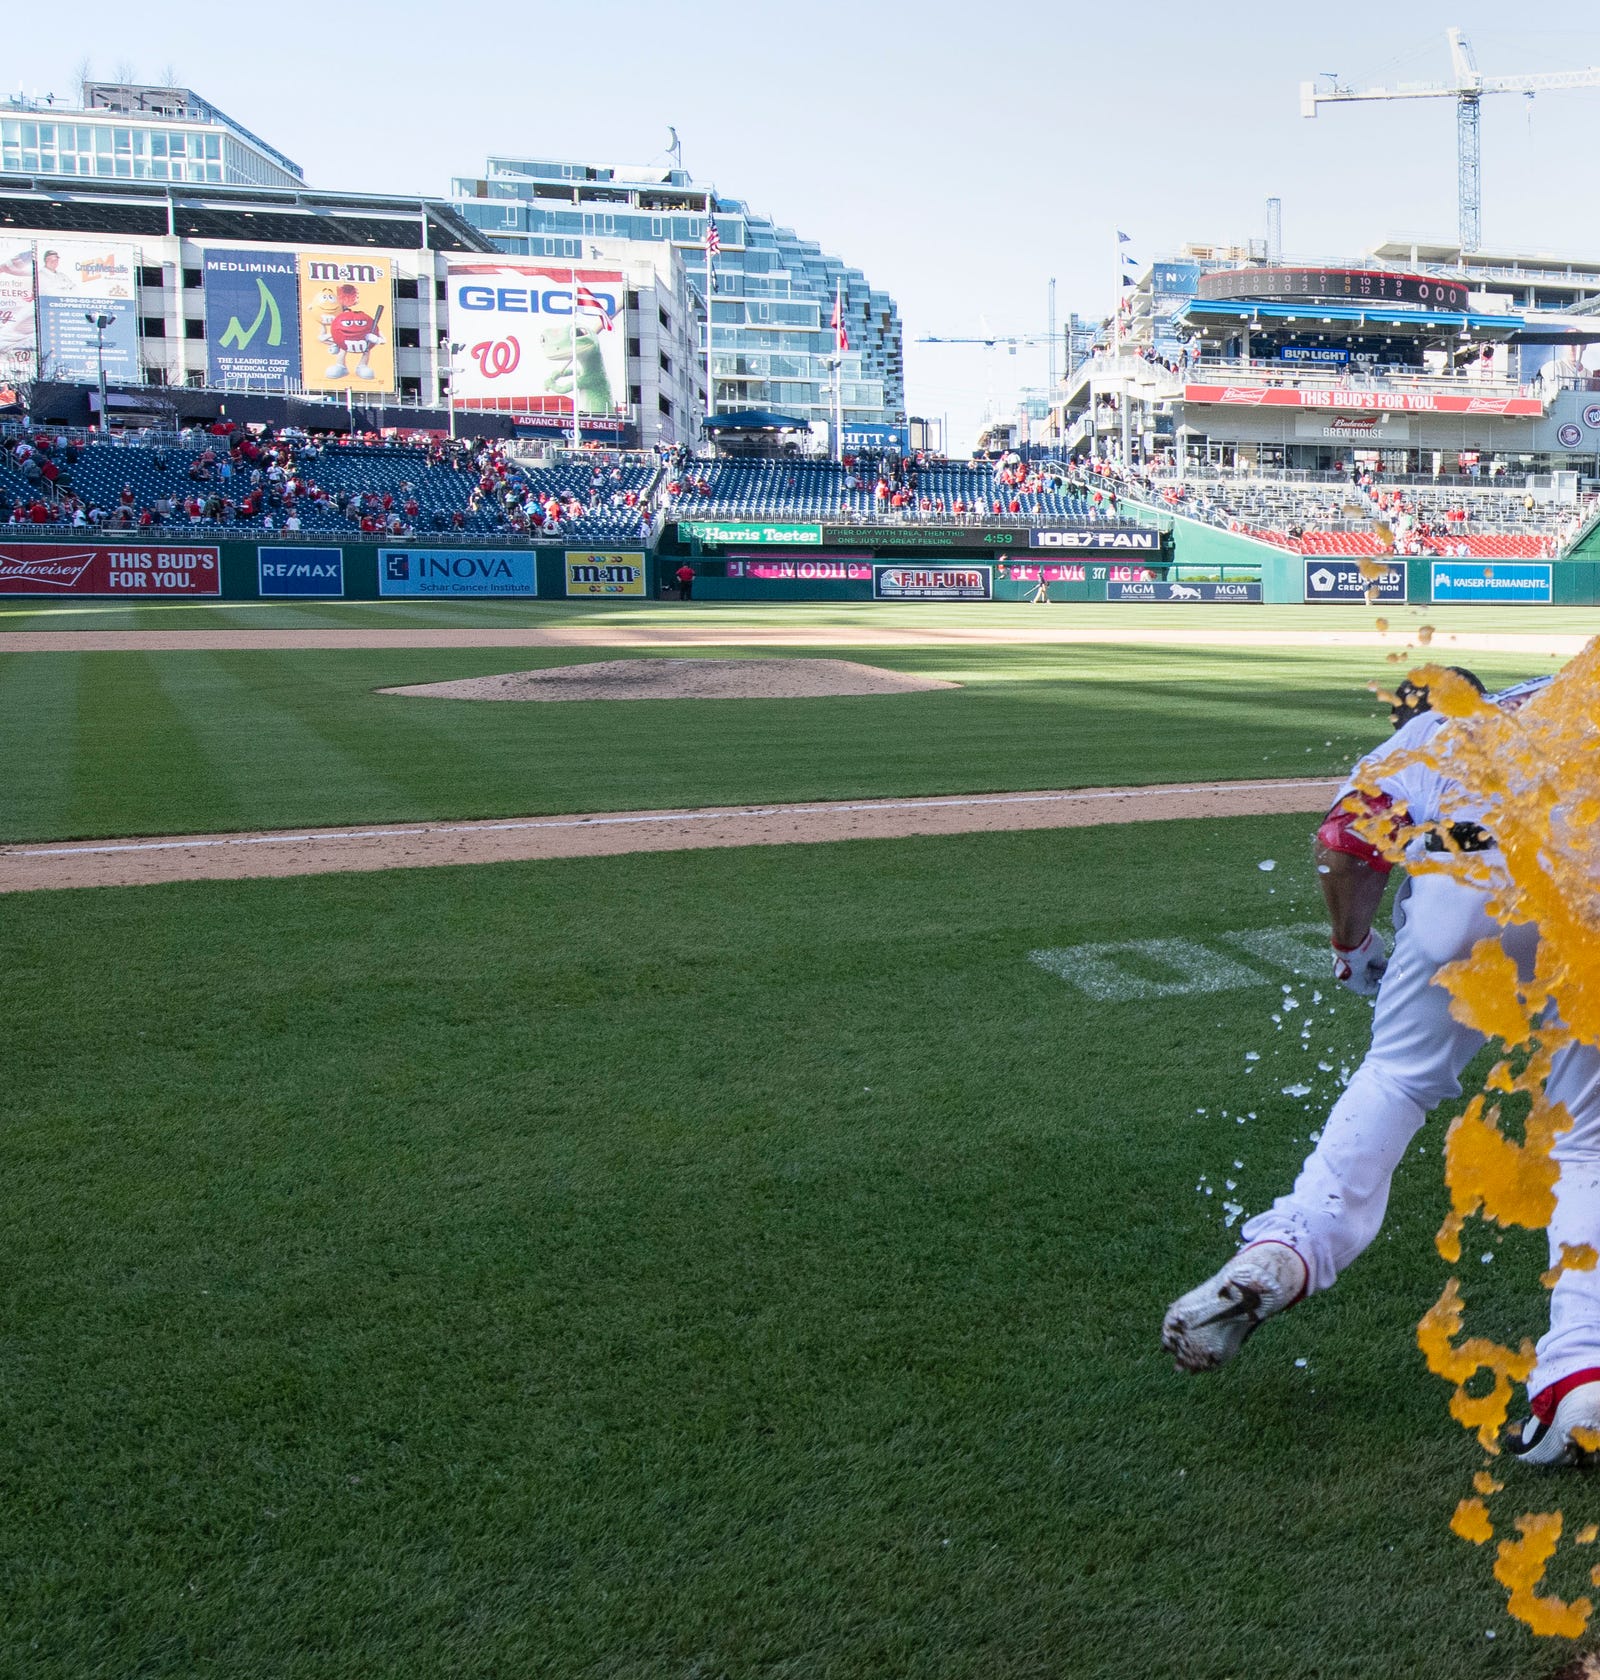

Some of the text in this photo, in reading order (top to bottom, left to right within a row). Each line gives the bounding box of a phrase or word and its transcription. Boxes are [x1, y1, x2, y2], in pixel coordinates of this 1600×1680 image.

[207, 261, 294, 274] MEDLIMINAL
[1155, 272, 1199, 282] ENVY
[1360, 277, 1371, 285] 10
[1380, 279, 1385, 287] 3
[1396, 280, 1402, 288] 9
[1360, 286, 1371, 294] 12
[1284, 349, 1347, 361] BUD LIGHT
[1350, 353, 1379, 362] LOFT
[234, 357, 268, 365] LEADING
[269, 358, 290, 366] EDGE
[226, 371, 281, 379] CONTAINMENT
[1299, 390, 1438, 410] THIS BUD'S FOR YOU.
[519, 416, 559, 427] ADVANCE
[592, 420, 619, 430] SALES
[1333, 418, 1375, 429] Budweiser
[1323, 427, 1384, 439] BREW HOUSE
[705, 527, 818, 542] Harris Teeter
[874, 529, 896, 537] WITH
[983, 533, 1013, 544] 4:59
[1097, 533, 1152, 547] FAN
[108, 552, 214, 570] THIS BUD'S
[262, 563, 338, 578] RE/MAX
[419, 557, 513, 578] INOVA
[1092, 567, 1107, 580] 377
[1337, 572, 1400, 584] PENED
[109, 571, 196, 588] FOR YOU.
[1453, 578, 1485, 587] KAISER
[420, 583, 531, 592] Schar Cancer Institute
[1121, 584, 1155, 594] MGM
[1215, 585, 1248, 595] MGM
[1337, 584, 1364, 592] CREDI
